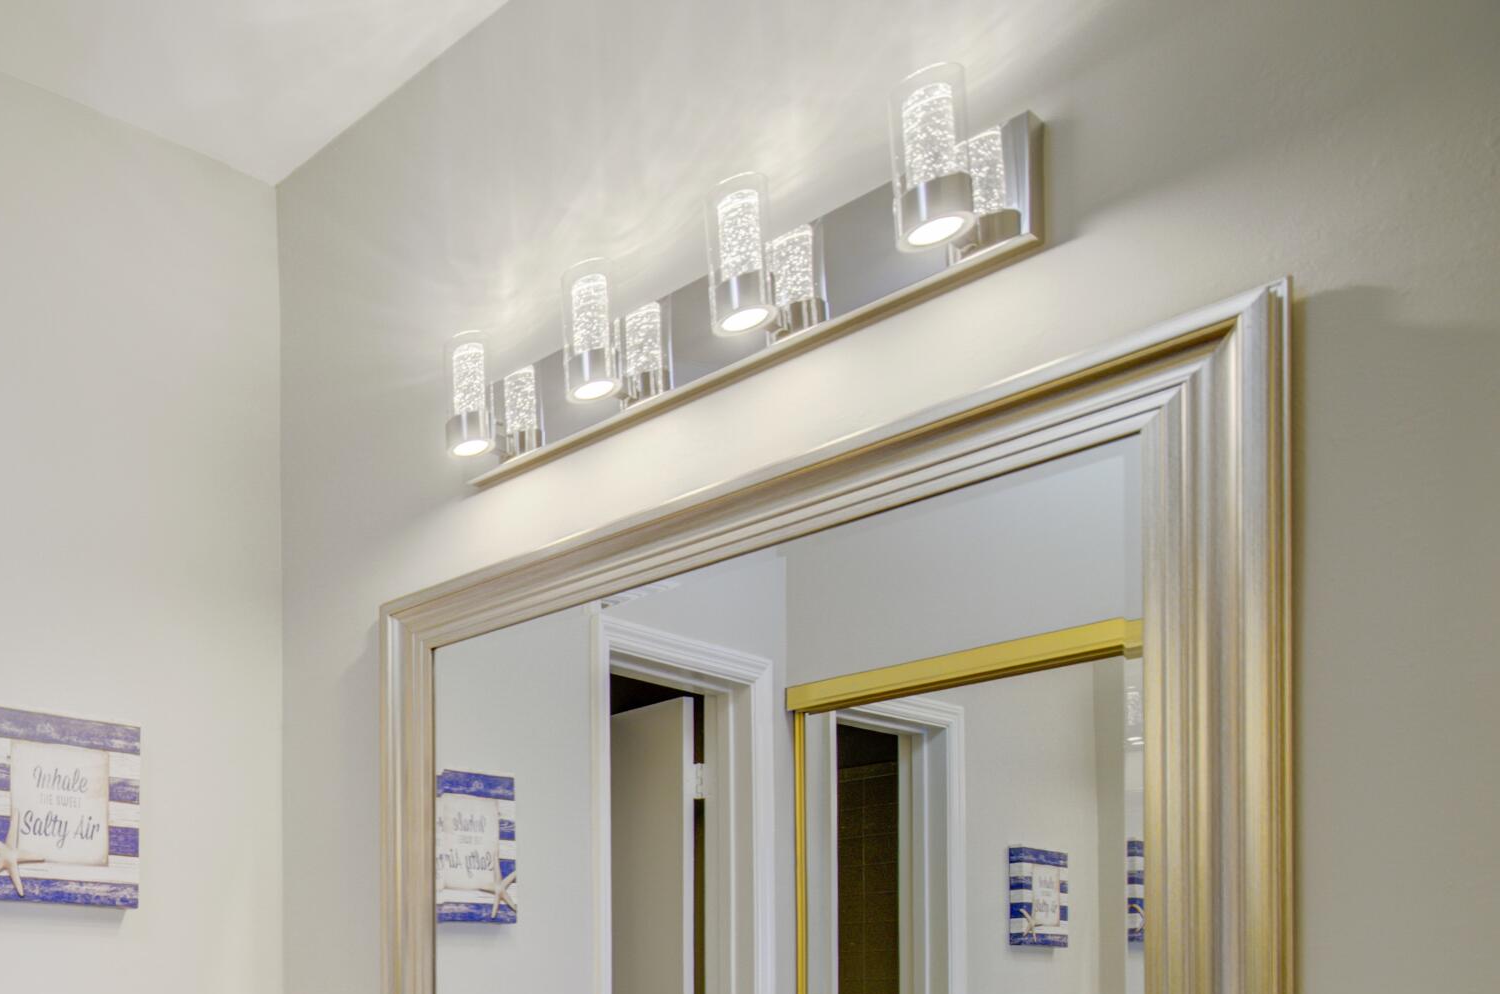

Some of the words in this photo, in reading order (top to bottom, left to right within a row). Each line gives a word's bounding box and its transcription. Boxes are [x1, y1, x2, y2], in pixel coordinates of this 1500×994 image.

[33, 765, 89, 793] Inhale
[20, 810, 69, 848] Salty
[74, 815, 100, 841] Air
